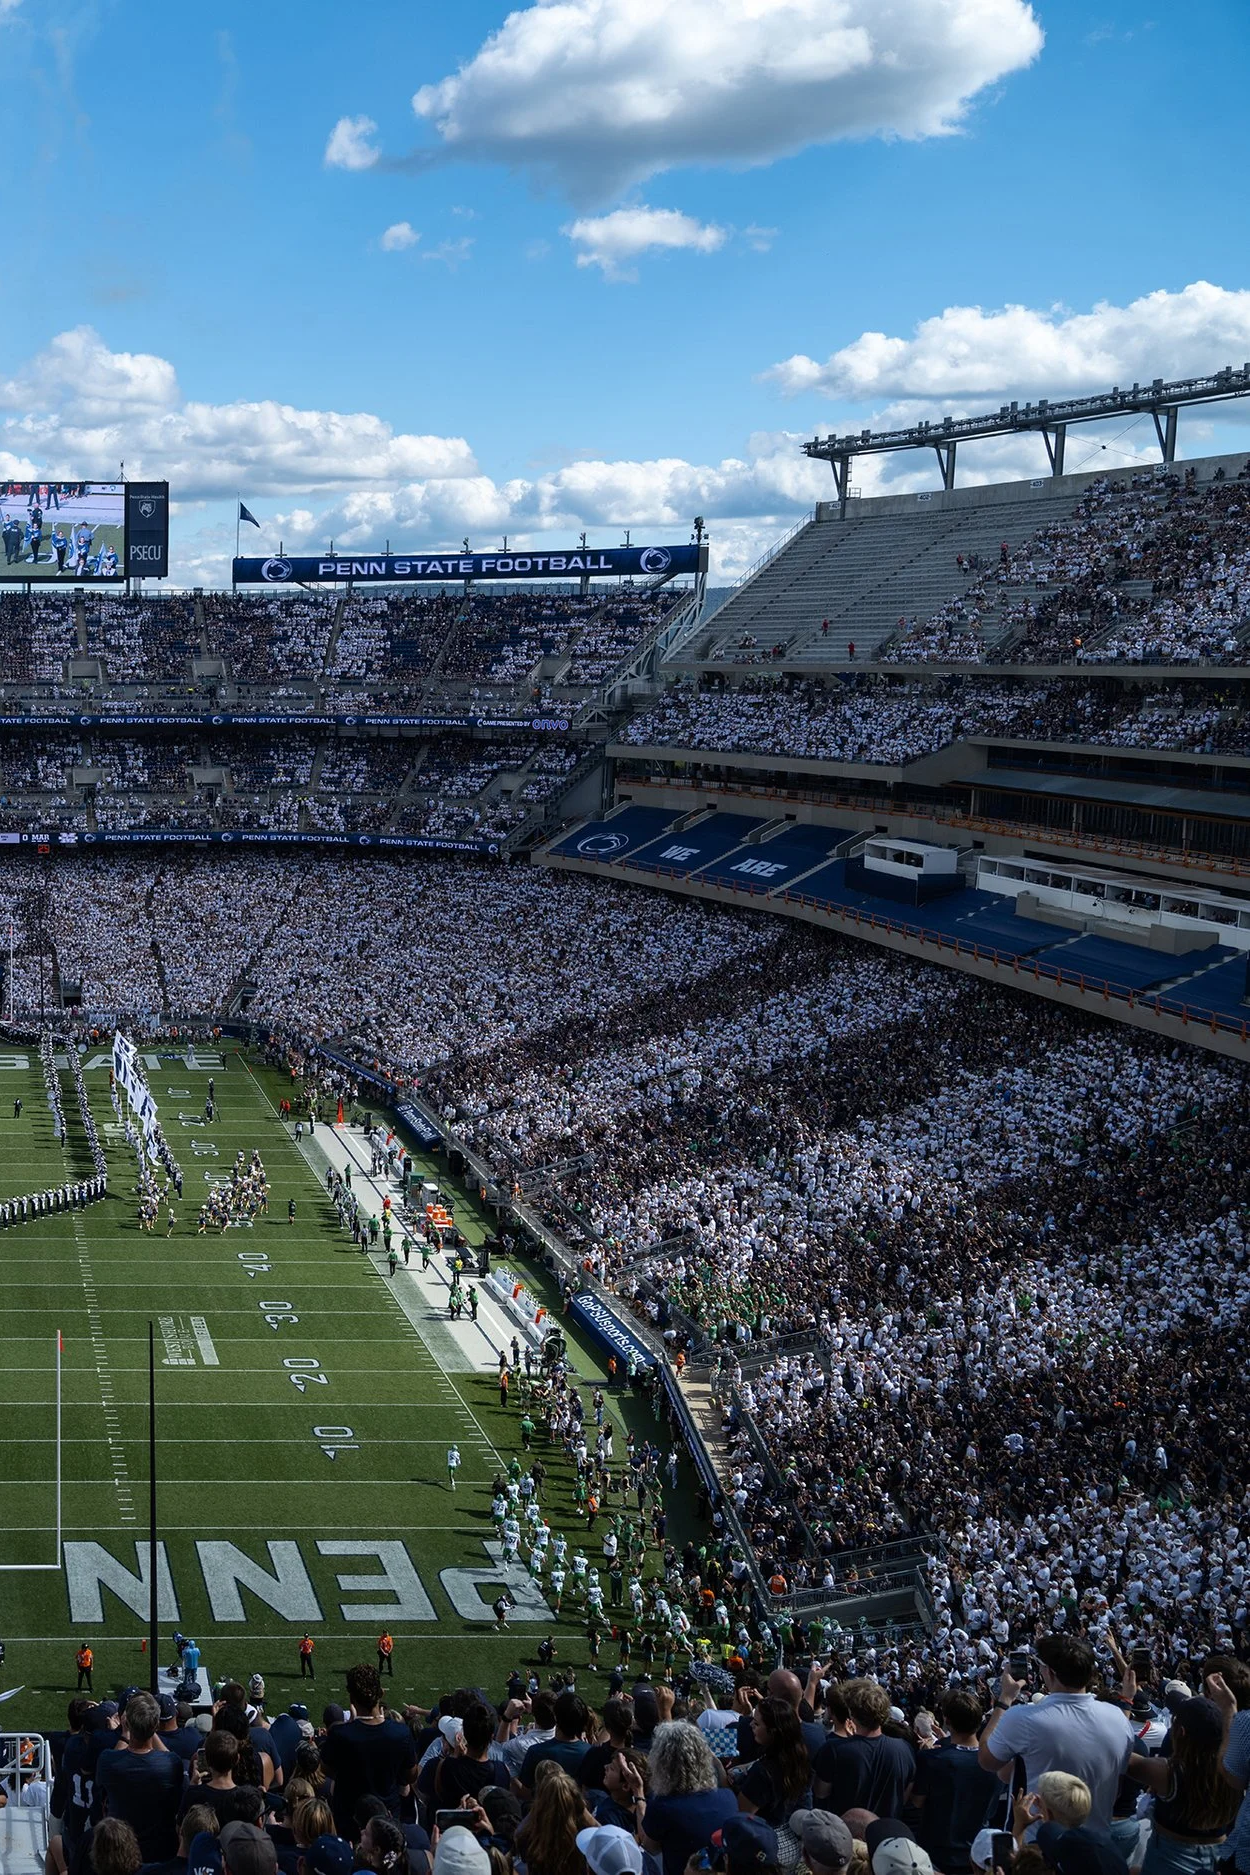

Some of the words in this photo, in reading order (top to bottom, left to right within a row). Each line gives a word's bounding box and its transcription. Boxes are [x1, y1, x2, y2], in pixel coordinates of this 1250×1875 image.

[130, 545, 162, 560] PSECU
[318, 561, 386, 575] PENN
[394, 559, 474, 574] STATE
[481, 555, 613, 573] FOOTBALL
[532, 719, 569, 731] onvo
[436, 841, 480, 850] FOOTBALL
[659, 845, 701, 861] WE
[730, 858, 788, 878] ARE
[237, 1252, 273, 1272] 40
[258, 1301, 299, 1324] 30
[576, 1295, 646, 1365] GoPSUsports.com
[282, 1358, 330, 1385] 20
[312, 1426, 360, 1450] 10
[62, 1539, 558, 1624] PENN
